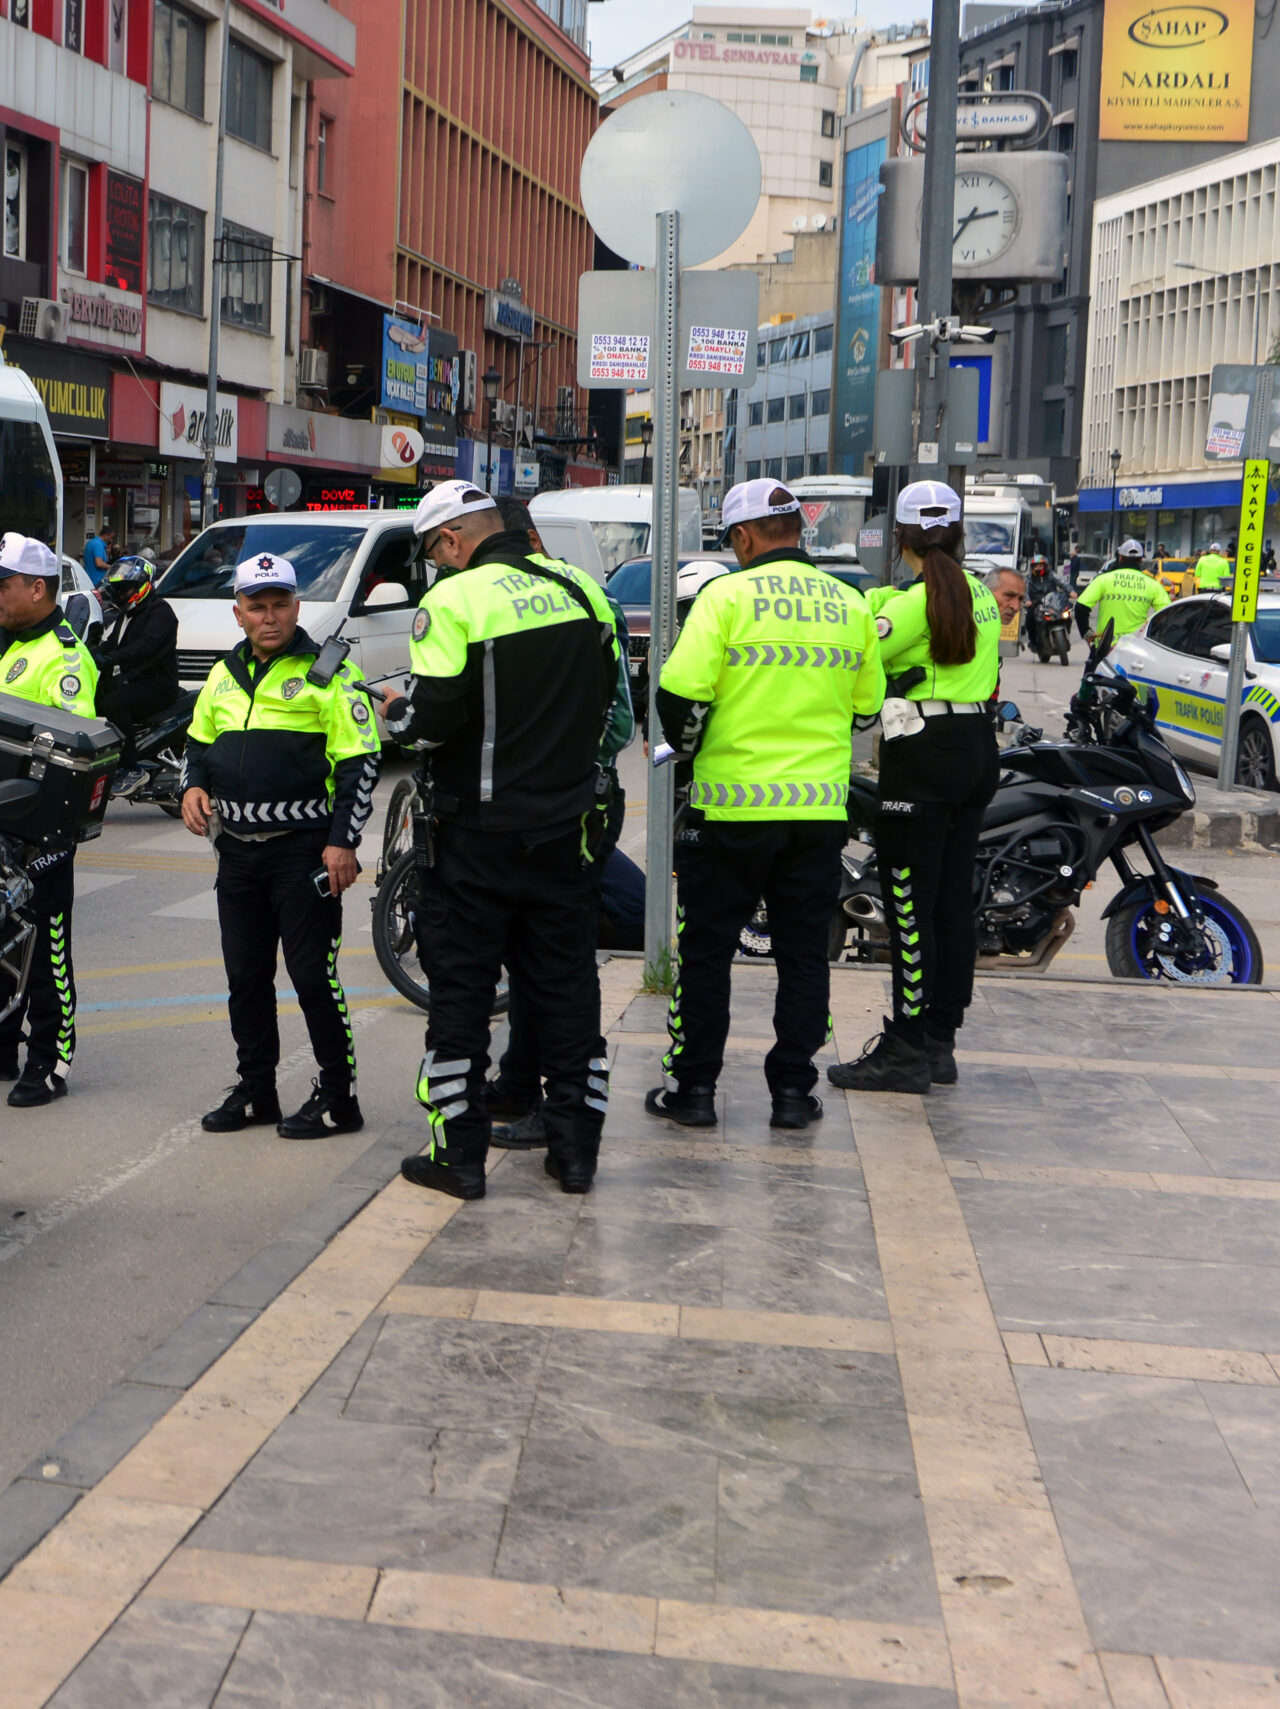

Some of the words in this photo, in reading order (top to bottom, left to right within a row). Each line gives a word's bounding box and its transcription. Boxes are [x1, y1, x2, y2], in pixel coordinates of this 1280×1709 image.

[1141, 20, 1207, 39] ŞAHAP
[674, 41, 720, 60] OTEL
[1121, 71, 1231, 89] NARDALI
[1163, 98, 1222, 108] MADENLER
[981, 115, 1028, 125] BANKASI
[961, 177, 980, 188] XII
[961, 249, 975, 261] VI
[692, 327, 710, 338] 0553
[711, 329, 725, 339] 948
[727, 330, 736, 340] 12
[737, 331, 746, 341] 12
[593, 335, 612, 345] 0553
[613, 336, 627, 346] 948
[629, 336, 638, 346] 12
[639, 337, 648, 346] 12
[717, 339, 745, 348] BANKA
[704, 345, 731, 354] ONAYLI
[689, 359, 707, 370] 0553
[708, 361, 722, 371] 948
[724, 362, 733, 372] 12
[734, 363, 744, 373] 12
[592, 367, 610, 377] 0553
[611, 368, 625, 378] 948
[627, 368, 636, 378] 12
[637, 368, 647, 379] 12
[1246, 483, 1260, 532] YAYA
[1240, 542, 1255, 617] GEÇİDİ
